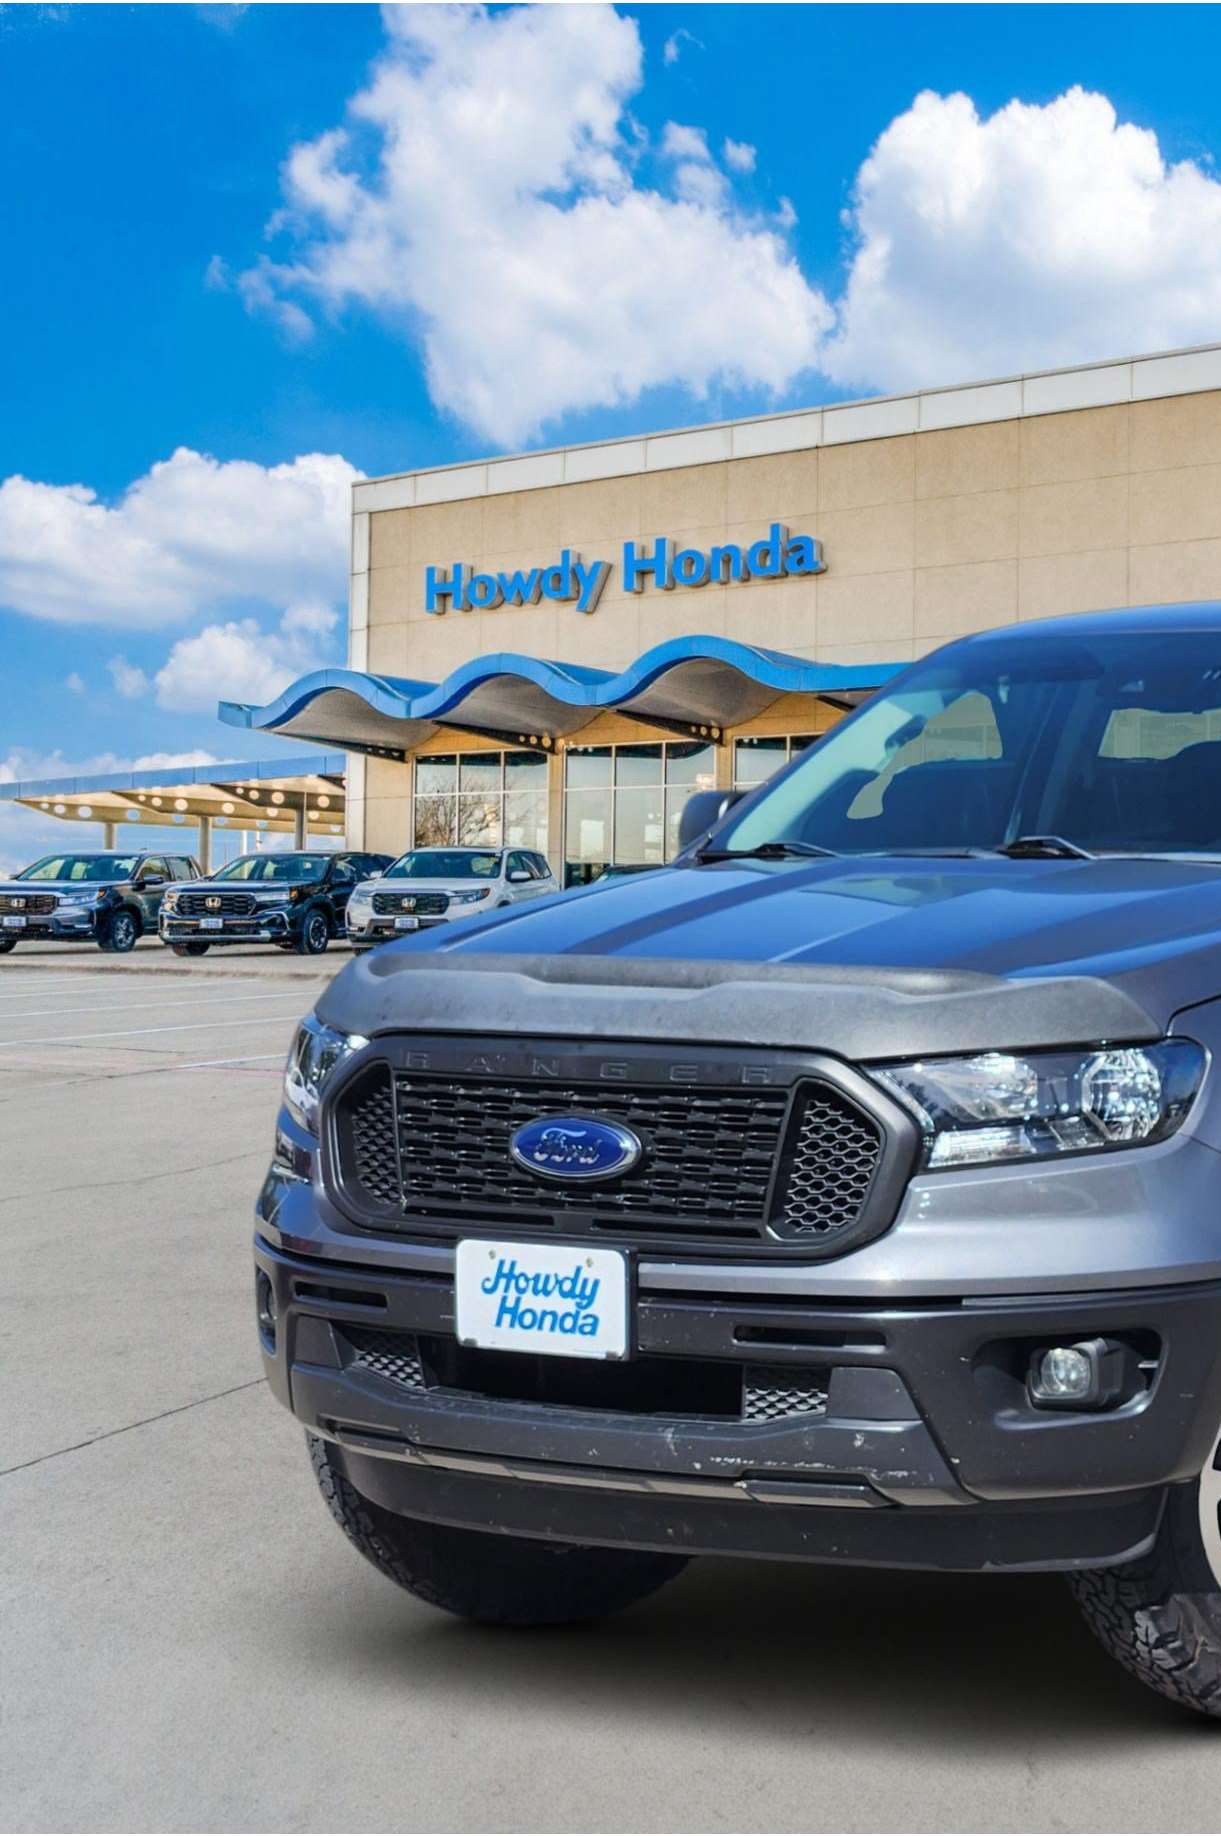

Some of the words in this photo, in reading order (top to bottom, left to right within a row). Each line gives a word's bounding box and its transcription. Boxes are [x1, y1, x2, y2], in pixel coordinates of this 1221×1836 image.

[425, 549, 611, 613] Howdy
[622, 522, 826, 593] Honda
[403, 1050, 771, 1085] RANGER
[533, 1126, 603, 1164] Ford
[481, 1258, 601, 1310] Howdy
[494, 1295, 600, 1337] Honda
